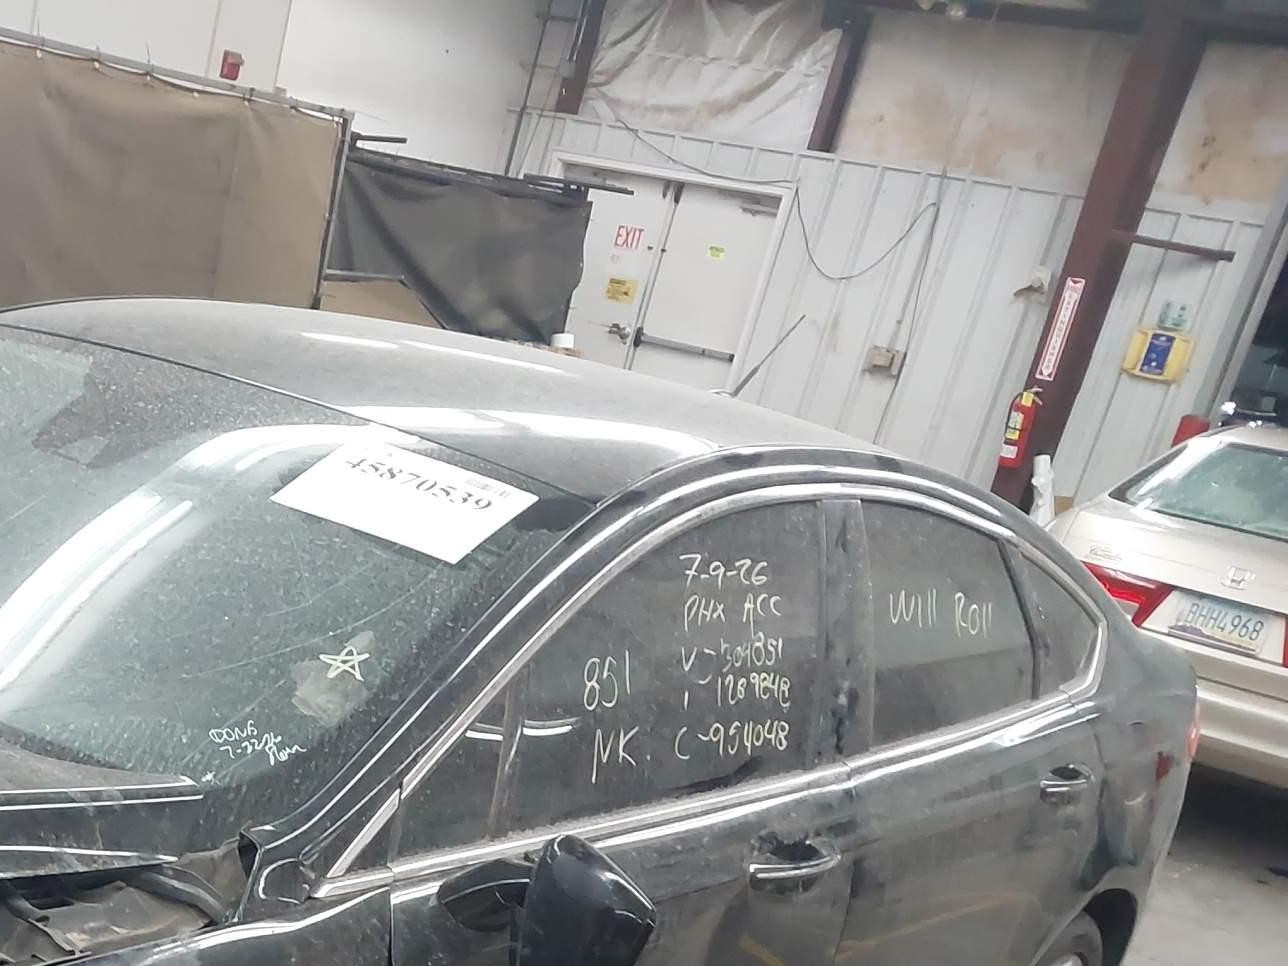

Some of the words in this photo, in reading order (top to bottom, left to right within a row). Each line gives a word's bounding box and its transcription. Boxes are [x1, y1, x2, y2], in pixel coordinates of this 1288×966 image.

[614, 224, 645, 250] EXIT
[345, 457, 493, 511] 45870539
[680, 553, 769, 590] 7-9-26
[743, 592, 783, 634] ACC
[1184, 602, 1265, 642] BHH4968
[583, 648, 632, 712] 851
